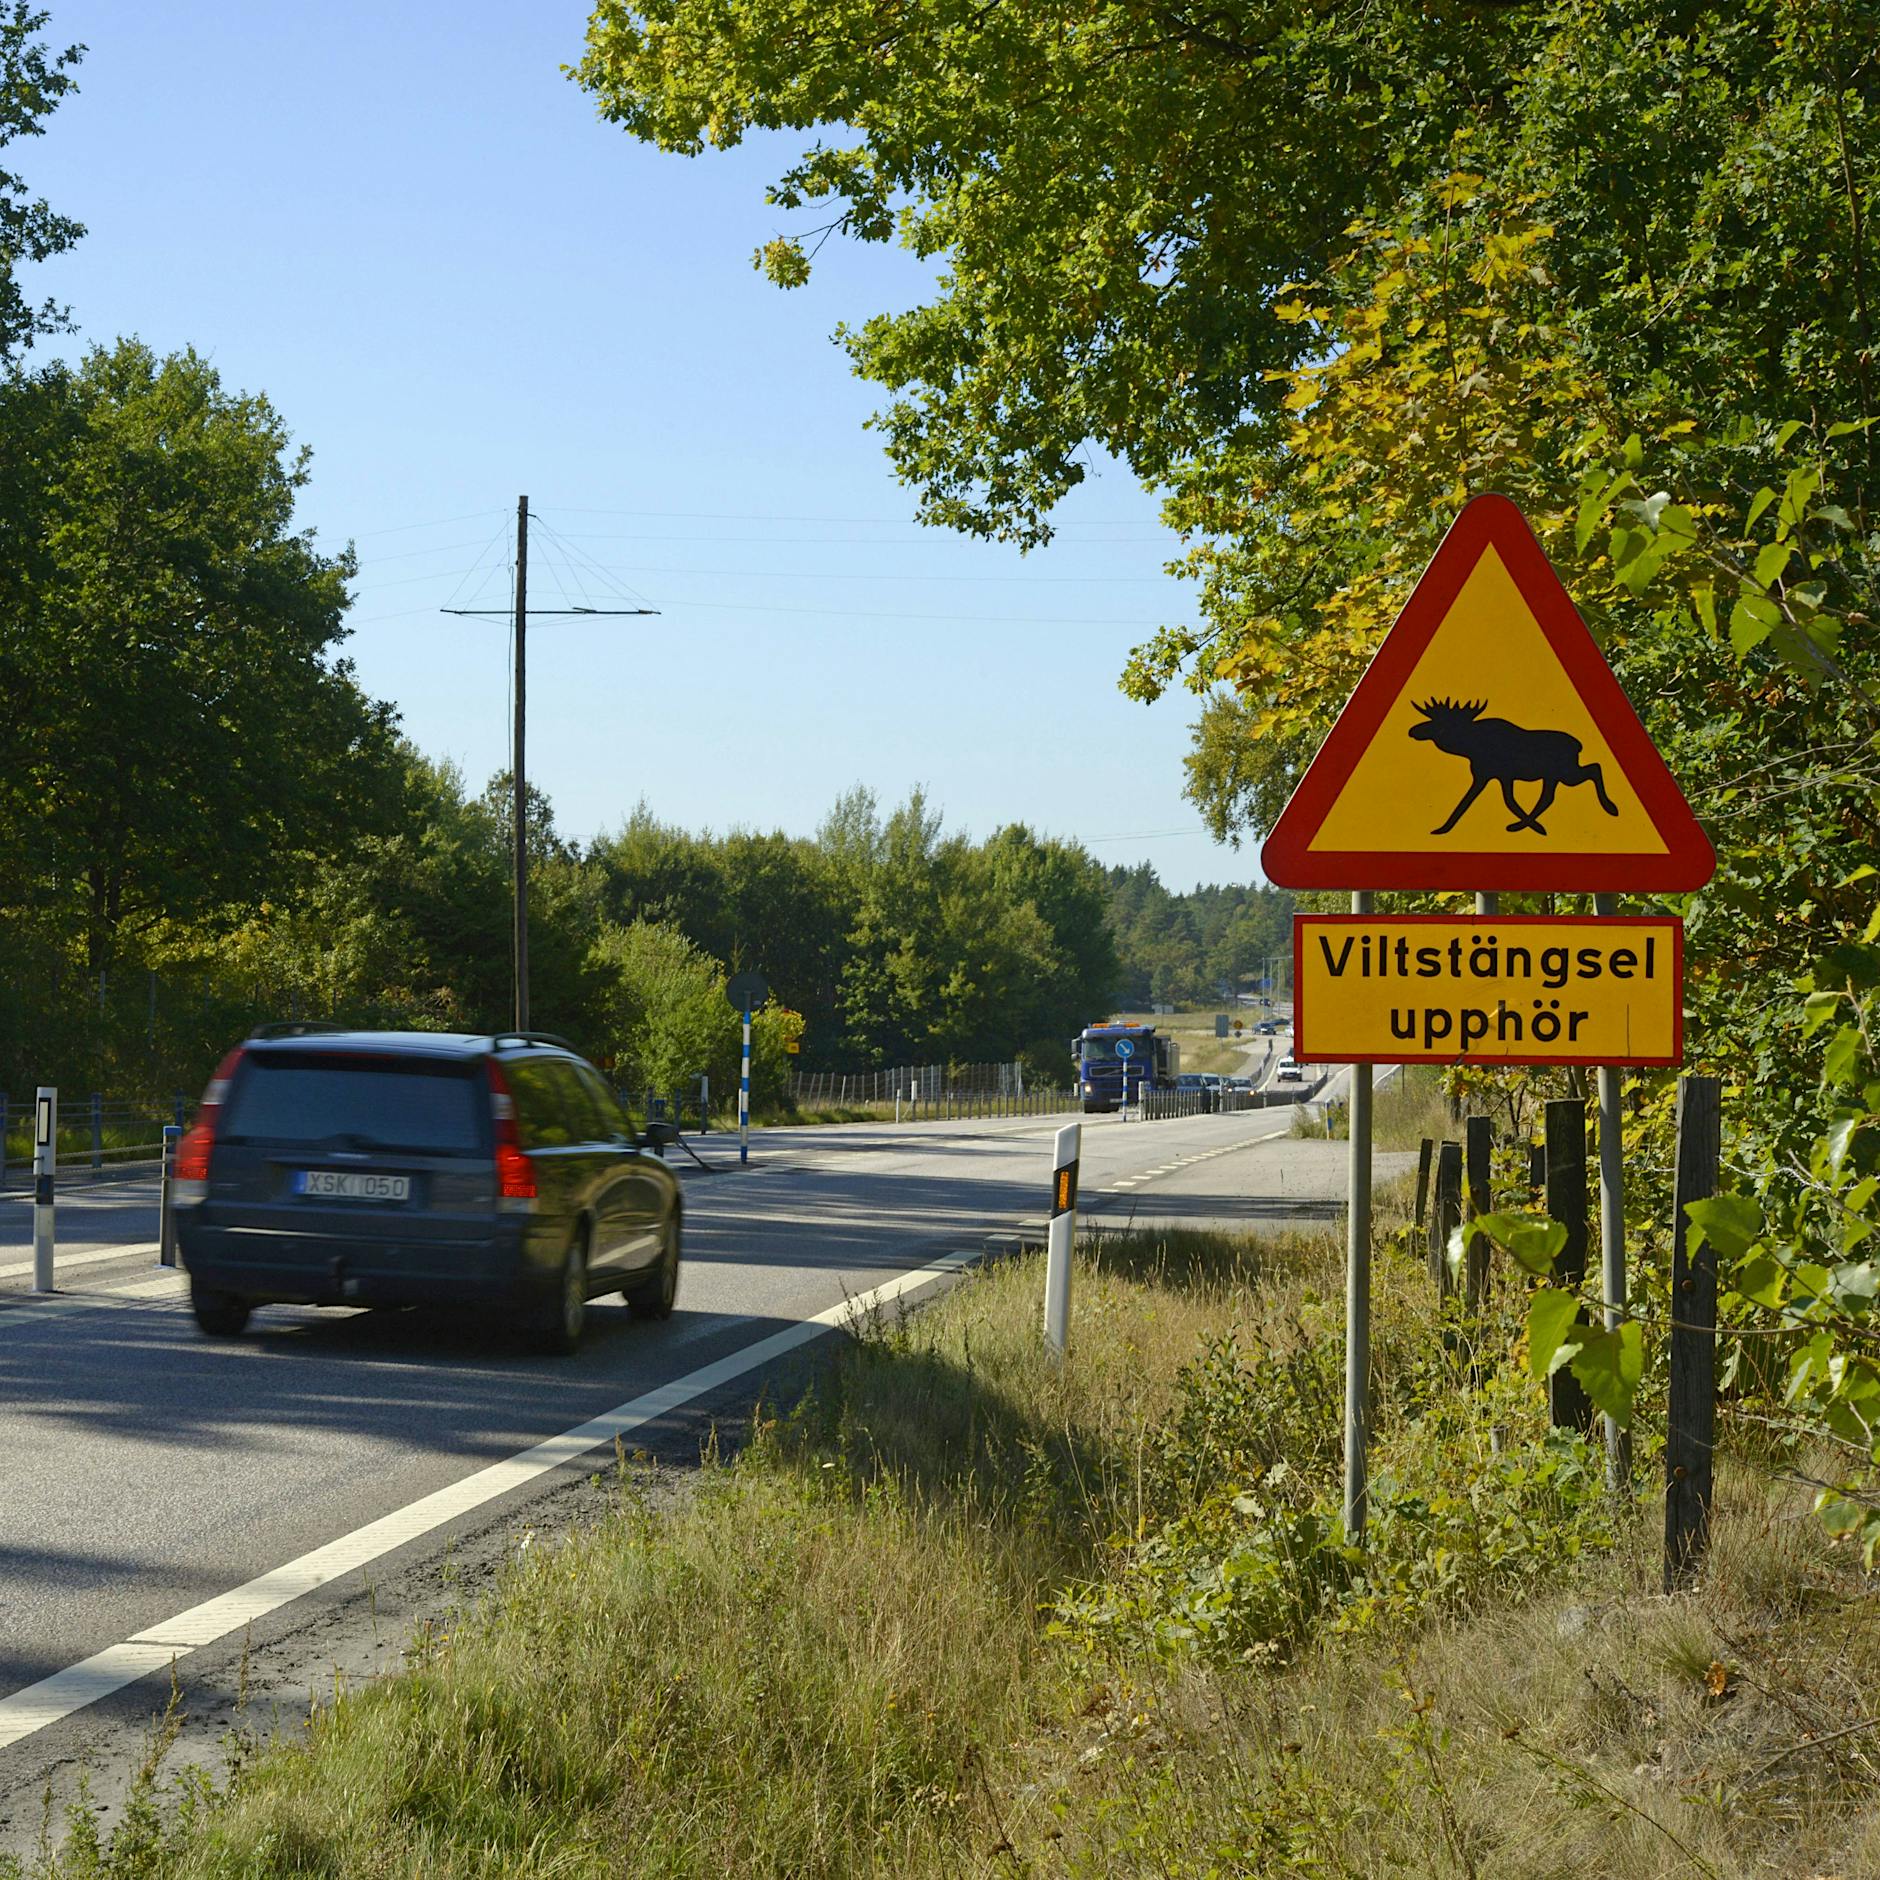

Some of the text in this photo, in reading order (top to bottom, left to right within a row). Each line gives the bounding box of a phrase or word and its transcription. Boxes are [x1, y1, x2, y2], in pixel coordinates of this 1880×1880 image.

[1319, 935, 1655, 989] Viltstängsel
[1391, 1000, 1589, 1049] upphör
[310, 1174, 404, 1197] XSK 050
